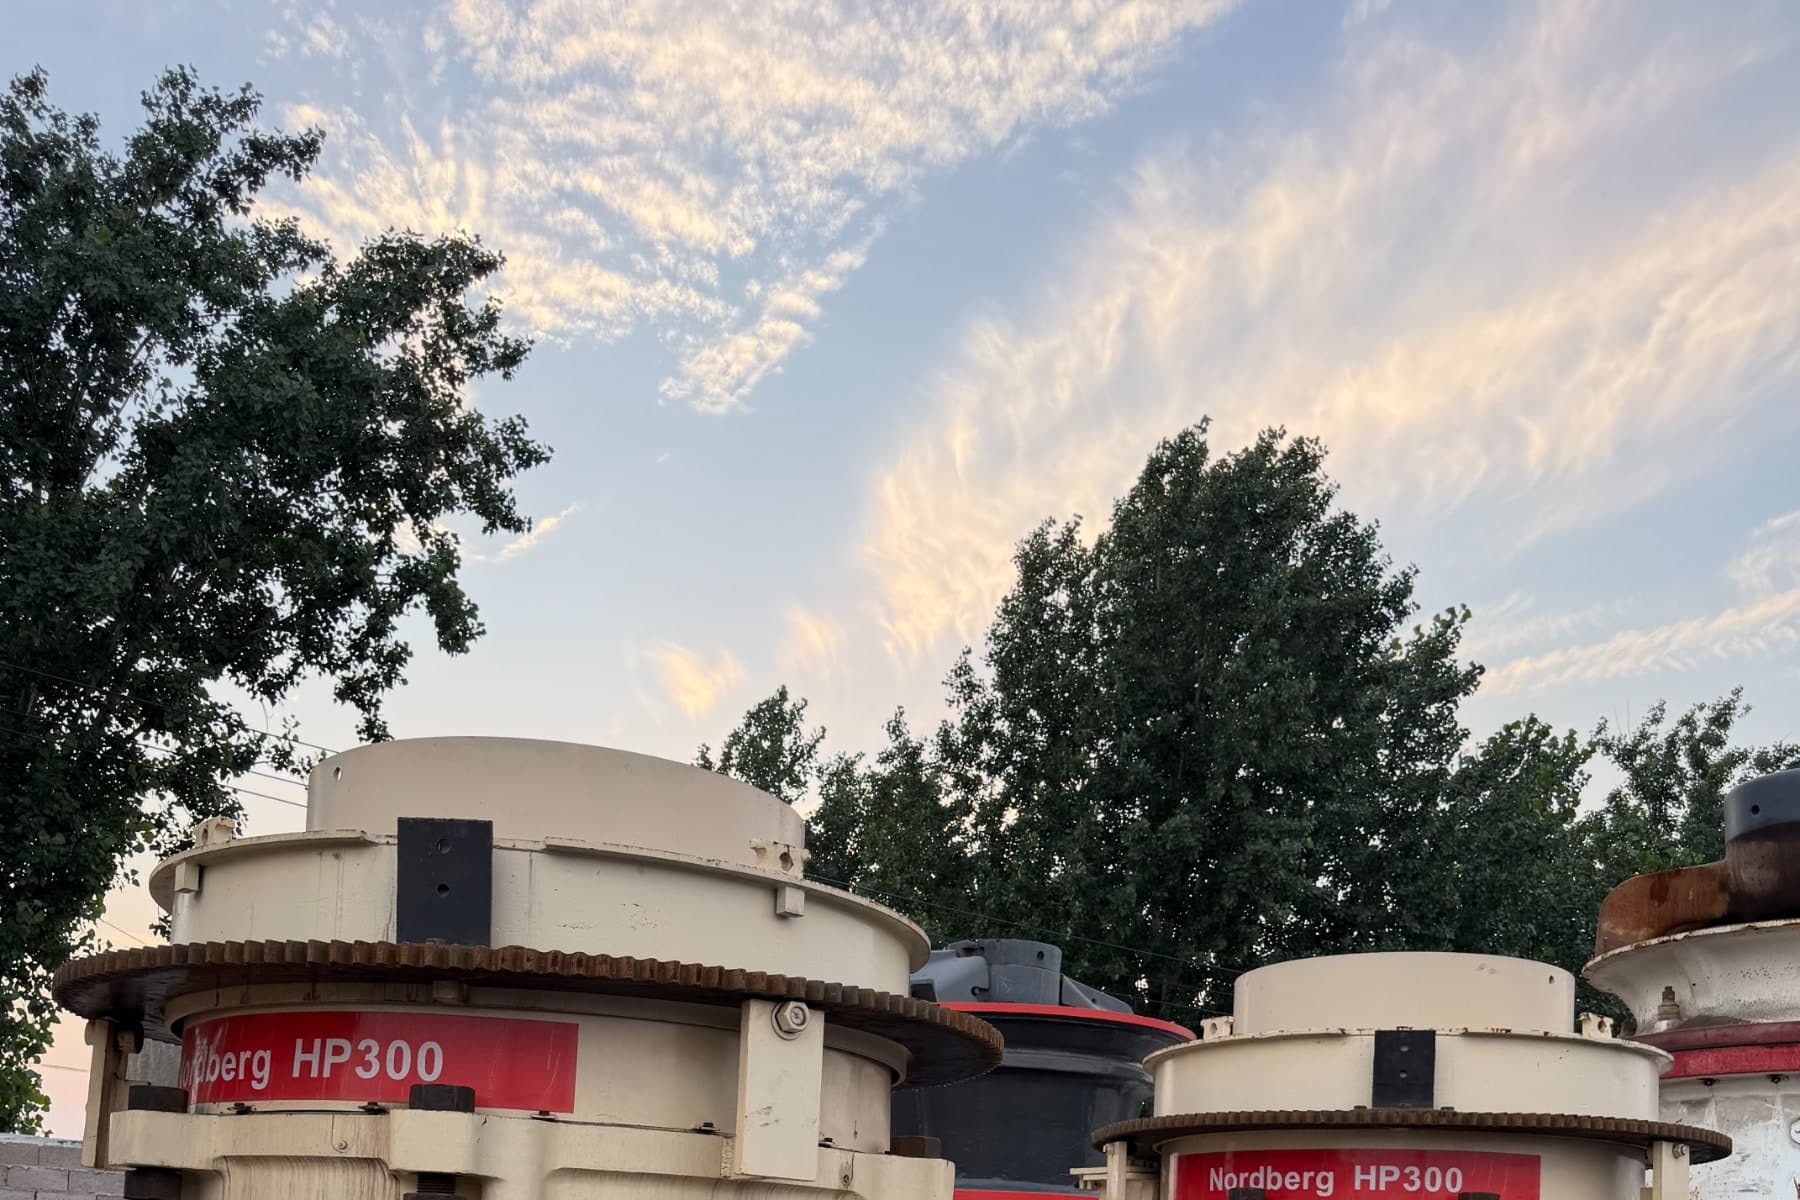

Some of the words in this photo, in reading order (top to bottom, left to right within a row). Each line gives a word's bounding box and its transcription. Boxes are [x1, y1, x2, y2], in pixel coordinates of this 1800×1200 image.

[292, 1038, 443, 1082] HP300
[1209, 1165, 1334, 1197] Nordberg
[1354, 1165, 1463, 1193] HP300
